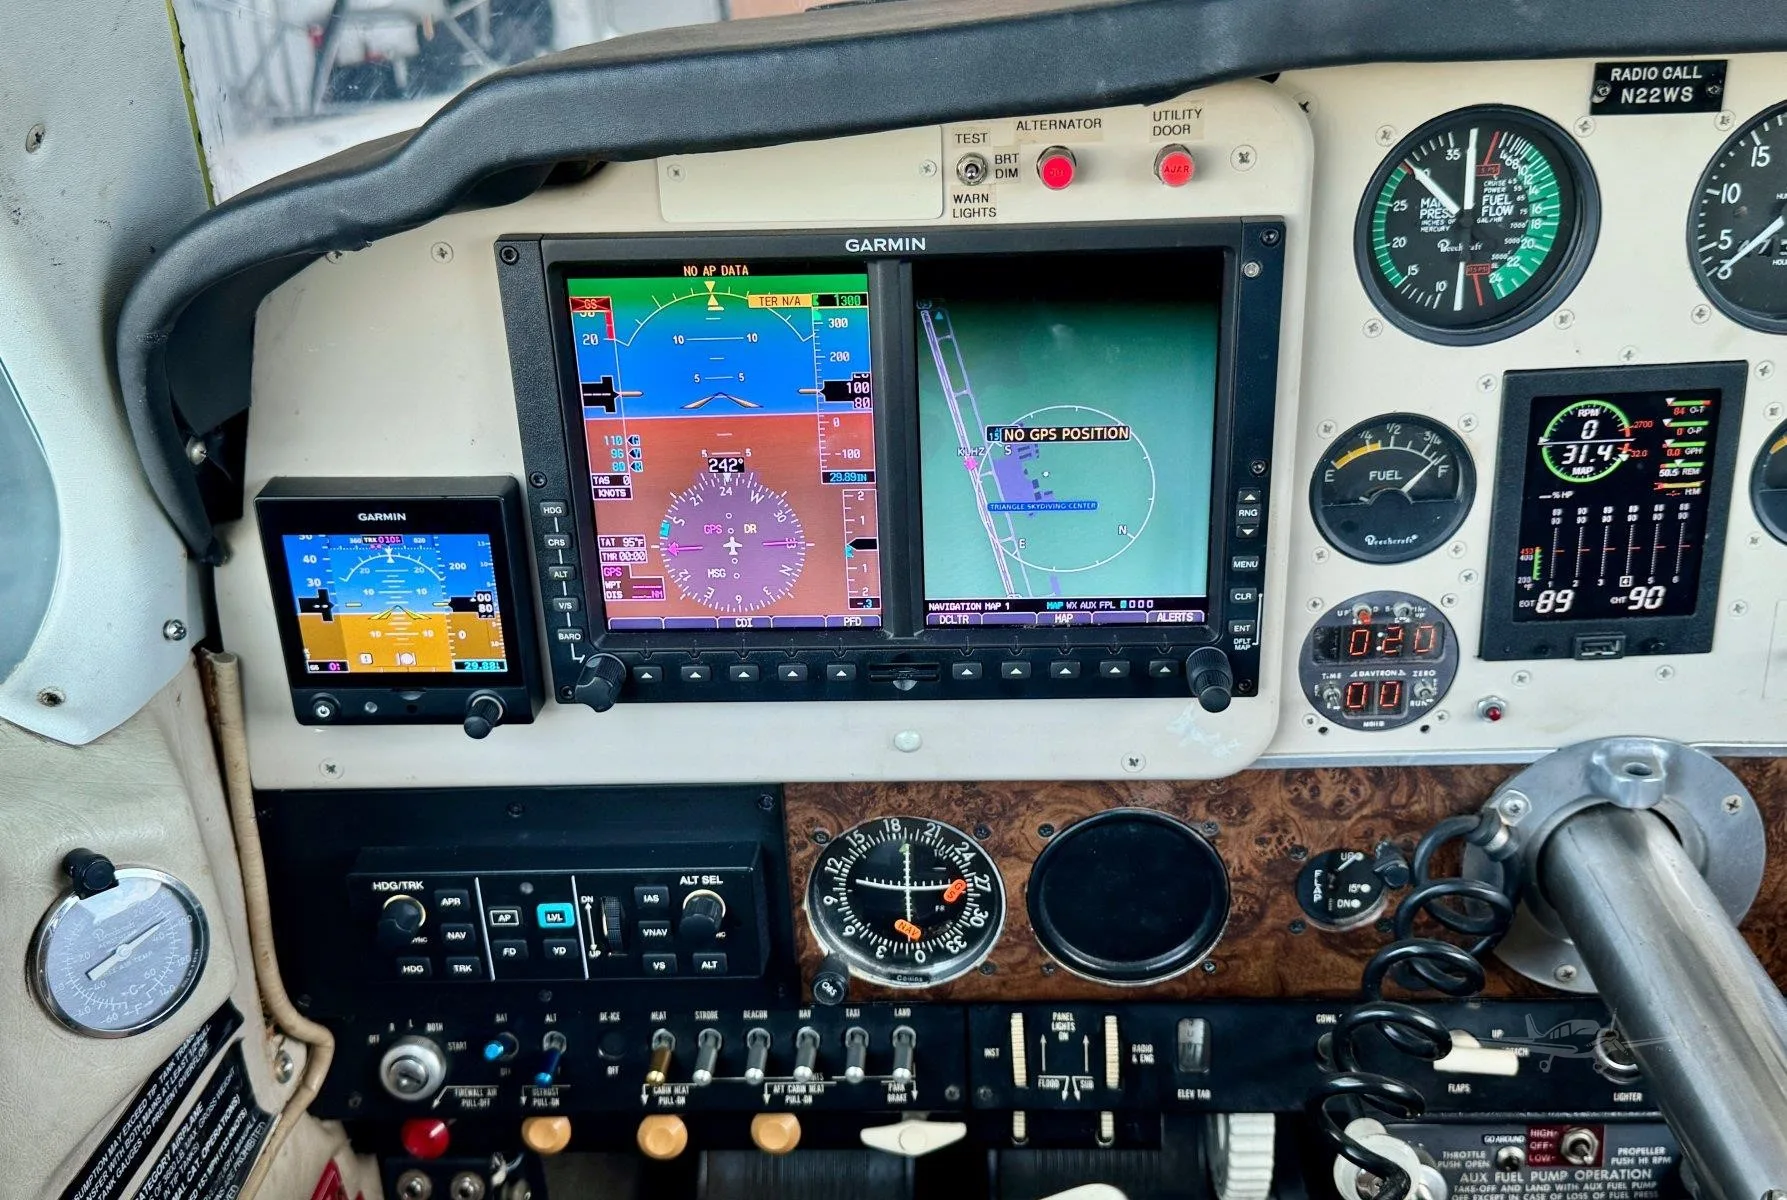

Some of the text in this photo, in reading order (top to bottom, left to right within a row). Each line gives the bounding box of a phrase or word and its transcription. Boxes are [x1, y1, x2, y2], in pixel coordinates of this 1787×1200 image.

[1611, 66, 1702, 81] RADIO CALL
[1621, 86, 1693, 104] N22WS
[1153, 108, 1203, 121] UTILITY
[1016, 118, 1102, 132] ALTERNATOR
[1153, 125, 1191, 136] DOOR
[955, 132, 988, 144] TEST
[995, 153, 1019, 165] BRT
[1446, 150, 1460, 160] 35
[1751, 146, 1769, 167] 15
[995, 167, 1018, 179] DIM
[1164, 165, 1190, 174] AJAR
[1721, 183, 1741, 204] 10
[953, 193, 989, 205] WARN
[1482, 194, 1512, 206] FUEL
[1393, 200, 1408, 211] 25
[952, 206, 997, 219] LIGHTS
[1482, 205, 1514, 217] FLOW
[1392, 237, 1407, 248] 20
[1718, 229, 1732, 250] 5
[845, 237, 926, 253] GARMIN
[683, 265, 749, 277] NO AP DATA
[1407, 265, 1419, 276] 15
[759, 296, 801, 306] TER N/A
[834, 294, 861, 306] 1300
[828, 318, 848, 329] 300
[582, 334, 599, 346] 20
[673, 335, 685, 345] 10
[747, 333, 758, 343] 10
[830, 352, 850, 362] 200
[1577, 408, 1600, 418] RPM
[1634, 420, 1653, 429] 2700
[1004, 426, 1129, 442] NO GPS POSITION
[1581, 420, 1598, 440] 0
[1561, 444, 1614, 465] 31.4
[708, 458, 744, 472] 242°
[1369, 470, 1403, 481] FUEL
[1437, 465, 1449, 479] F
[1571, 466, 1595, 476] MAP
[593, 476, 611, 485] TAS
[1324, 470, 1335, 483] E
[598, 489, 627, 498] KNOTS
[543, 506, 562, 515] HDG
[990, 503, 1025, 511] TRIANGLE
[1027, 503, 1066, 511] SKYDIVING
[357, 512, 407, 522] GARMIN
[1238, 509, 1258, 517] RNG
[704, 523, 757, 535] GPS DR
[548, 539, 565, 547] CRS
[600, 537, 616, 548] TAT
[303, 555, 317, 564] 40
[1233, 560, 1259, 568] MENU
[449, 562, 467, 570] 200
[554, 570, 568, 579] ALT
[603, 566, 622, 577] GPS
[707, 568, 726, 579] MSG
[307, 578, 321, 587] 30
[1235, 592, 1252, 600] CLR
[1535, 589, 1574, 613] 89
[1628, 586, 1666, 610] 90
[559, 602, 573, 610] V/S
[928, 601, 1002, 611] NAVIGATION MAP
[1080, 600, 1116, 609] AUX FPL
[735, 617, 754, 628] CDI
[843, 616, 862, 626] PFD
[939, 614, 969, 625] DCLTR
[1055, 613, 1073, 624] MAP
[1157, 612, 1194, 623] ALERTS
[1234, 624, 1251, 632] ENT
[558, 633, 582, 641] BARO
[1359, 669, 1398, 677] DAVTRON
[883, 818, 901, 832] 18
[924, 823, 941, 838] 21
[679, 875, 723, 885] ALT SEL
[373, 881, 424, 891] HDG/TRK
[441, 897, 461, 906] APR
[643, 895, 660, 903] IAS
[1337, 899, 1351, 908] DN
[498, 914, 511, 922] AP
[547, 913, 563, 922] LVL
[643, 929, 668, 937] VNAV
[898, 921, 918, 938] NAV
[447, 931, 466, 940] NAV
[502, 947, 517, 955] FD
[552, 947, 566, 955] YD
[403, 964, 424, 973] HDG
[453, 964, 473, 972] TRK
[652, 962, 666, 970] VS
[701, 961, 718, 969] ALT
[821, 981, 838, 997] OBS
[651, 1010, 667, 1020] HEAT
[695, 1010, 719, 1020] STROBE
[743, 1009, 768, 1020] BEACON
[894, 1008, 911, 1018] LAND
[1052, 1012, 1074, 1021] PANEL
[1316, 1014, 1337, 1024] COWL
[1052, 1022, 1076, 1032] LIGHTS
[984, 1048, 999, 1058] INST
[1132, 1044, 1154, 1054] RADIO
[808, 1084, 825, 1094] HEAT
[1038, 1079, 1060, 1089] FLOOD
[1448, 1083, 1471, 1094] FLAPS
[653, 1085, 690, 1095] CABIN HEAT
[1178, 1089, 1211, 1099] ELEV TAB
[122, 1058, 175, 1136] EXCEED TANK
[1613, 1092, 1642, 1102] LIGHTER
[107, 1146, 125, 1173] WITH
[124, 1121, 144, 1149] BOTH
[142, 1094, 162, 1124] MAINS
[170, 1055, 188, 1085] LEAST
[171, 1101, 204, 1154] AIRPLANE
[201, 1093, 241, 1158] OPERATIONS)
[115, 1087, 178, 1178] GAUGES PREVENT
[1498, 1135, 1525, 1143] AROUND
[235, 1121, 267, 1172] PROHIBITED
[1618, 1147, 1665, 1156] PROPELLER
[1443, 1151, 1486, 1159] THROTTLE
[1437, 1160, 1490, 1168] PUSH OPEN
[1611, 1156, 1671, 1165] PUSH RPM
[1460, 1169, 1651, 1183] AUX FUEL PUMP OPERATION
[1454, 1181, 1657, 1193] TAKE-OFF AND LAND WITH AUX FUEL PUMP
[1567, 1190, 1629, 1200] LOSS FUEL
